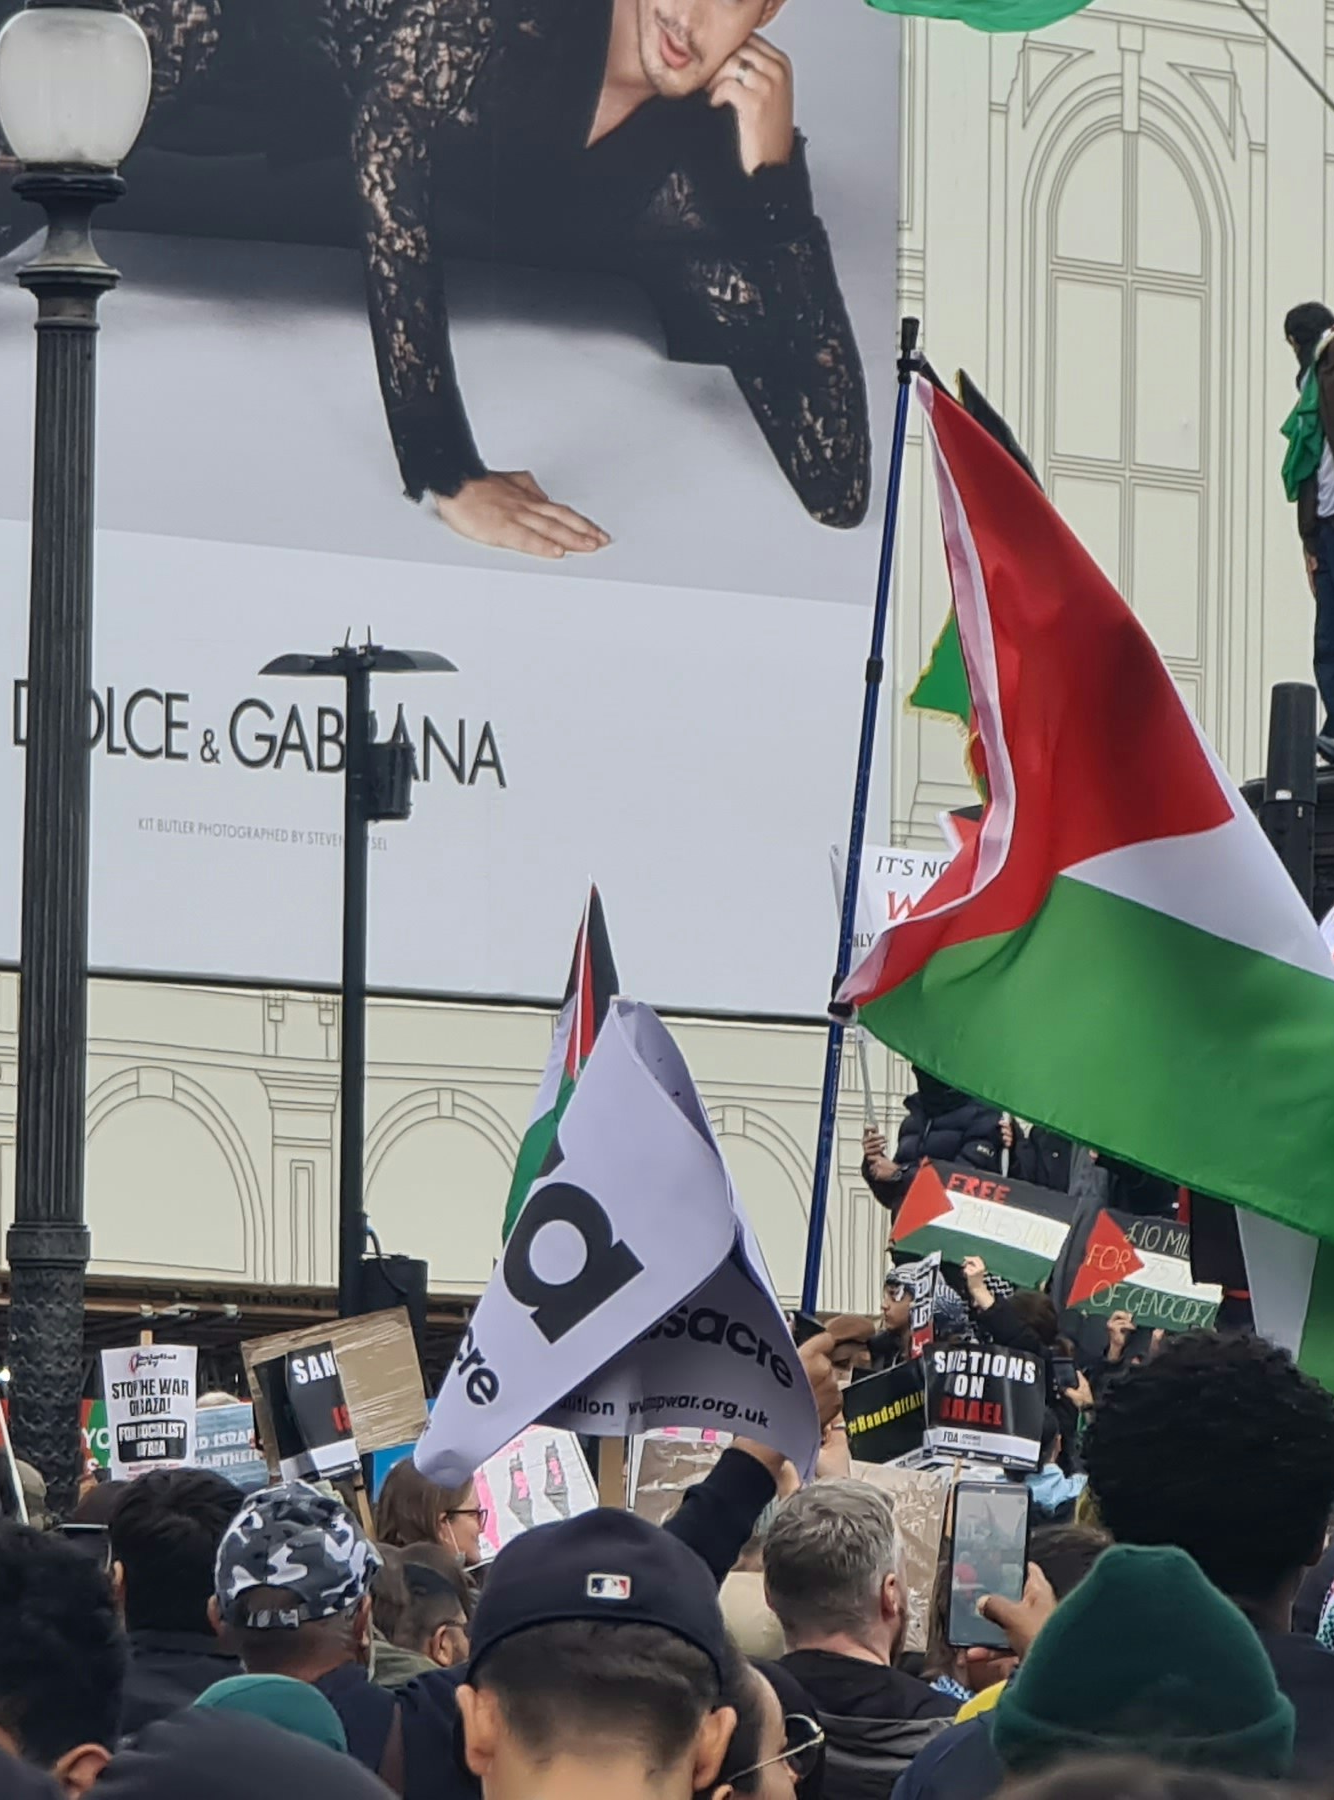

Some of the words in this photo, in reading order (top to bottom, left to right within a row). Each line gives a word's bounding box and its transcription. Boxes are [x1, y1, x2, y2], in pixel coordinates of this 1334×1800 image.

[200, 729, 220, 765] &
[229, 698, 507, 789] GABANA
[138, 817, 154, 831] KIT
[157, 818, 195, 835] BUTLER
[198, 822, 289, 843] PHOTOGRAPHED
[291, 830, 305, 844] BY
[876, 855, 915, 877] IT'S
[946, 1172, 1012, 1204] FREE
[1162, 1229, 1190, 1259] MIL
[1085, 1243, 1132, 1273] FOR
[1091, 1280, 1127, 1307] OF
[159, 1378, 189, 1396] WAR
[954, 1374, 985, 1399] ON
